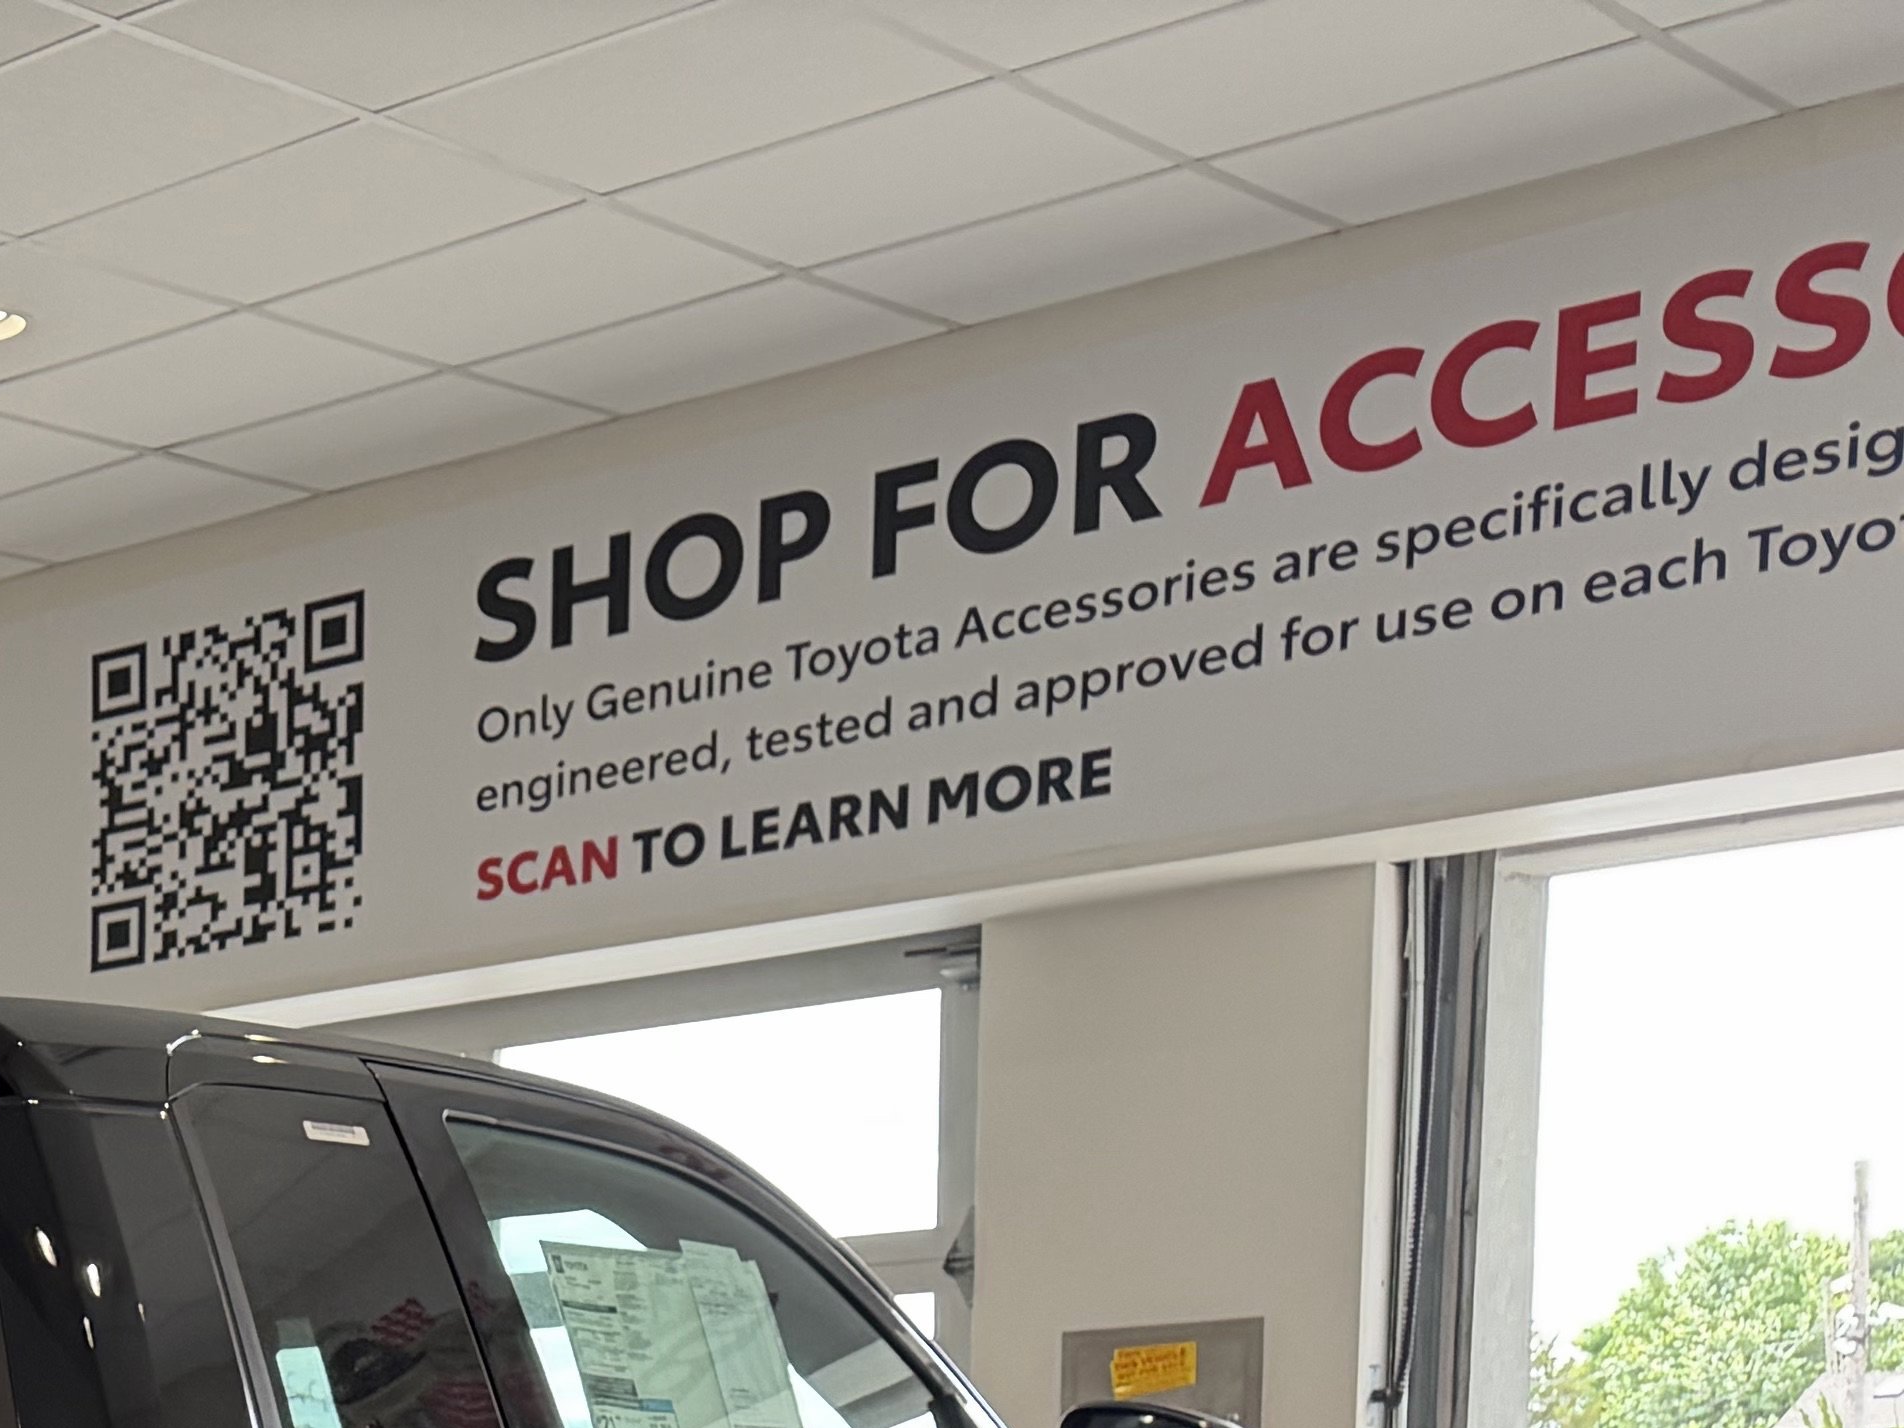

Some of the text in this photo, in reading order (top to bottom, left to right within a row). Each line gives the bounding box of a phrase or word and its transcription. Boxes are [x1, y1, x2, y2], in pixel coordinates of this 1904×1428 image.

[474, 241, 1904, 663] SHOP FOR ACCESS
[476, 513, 1904, 813] engineered, tested and approved for use on each Toyo
[477, 695, 574, 743] Only
[587, 660, 772, 721] Genuine
[787, 623, 940, 684] Toyota
[955, 559, 1256, 649] Accessories
[1273, 539, 1359, 585] are
[1376, 459, 1712, 570] specifically
[476, 747, 1113, 901] SCAN TO LEARN MORE
